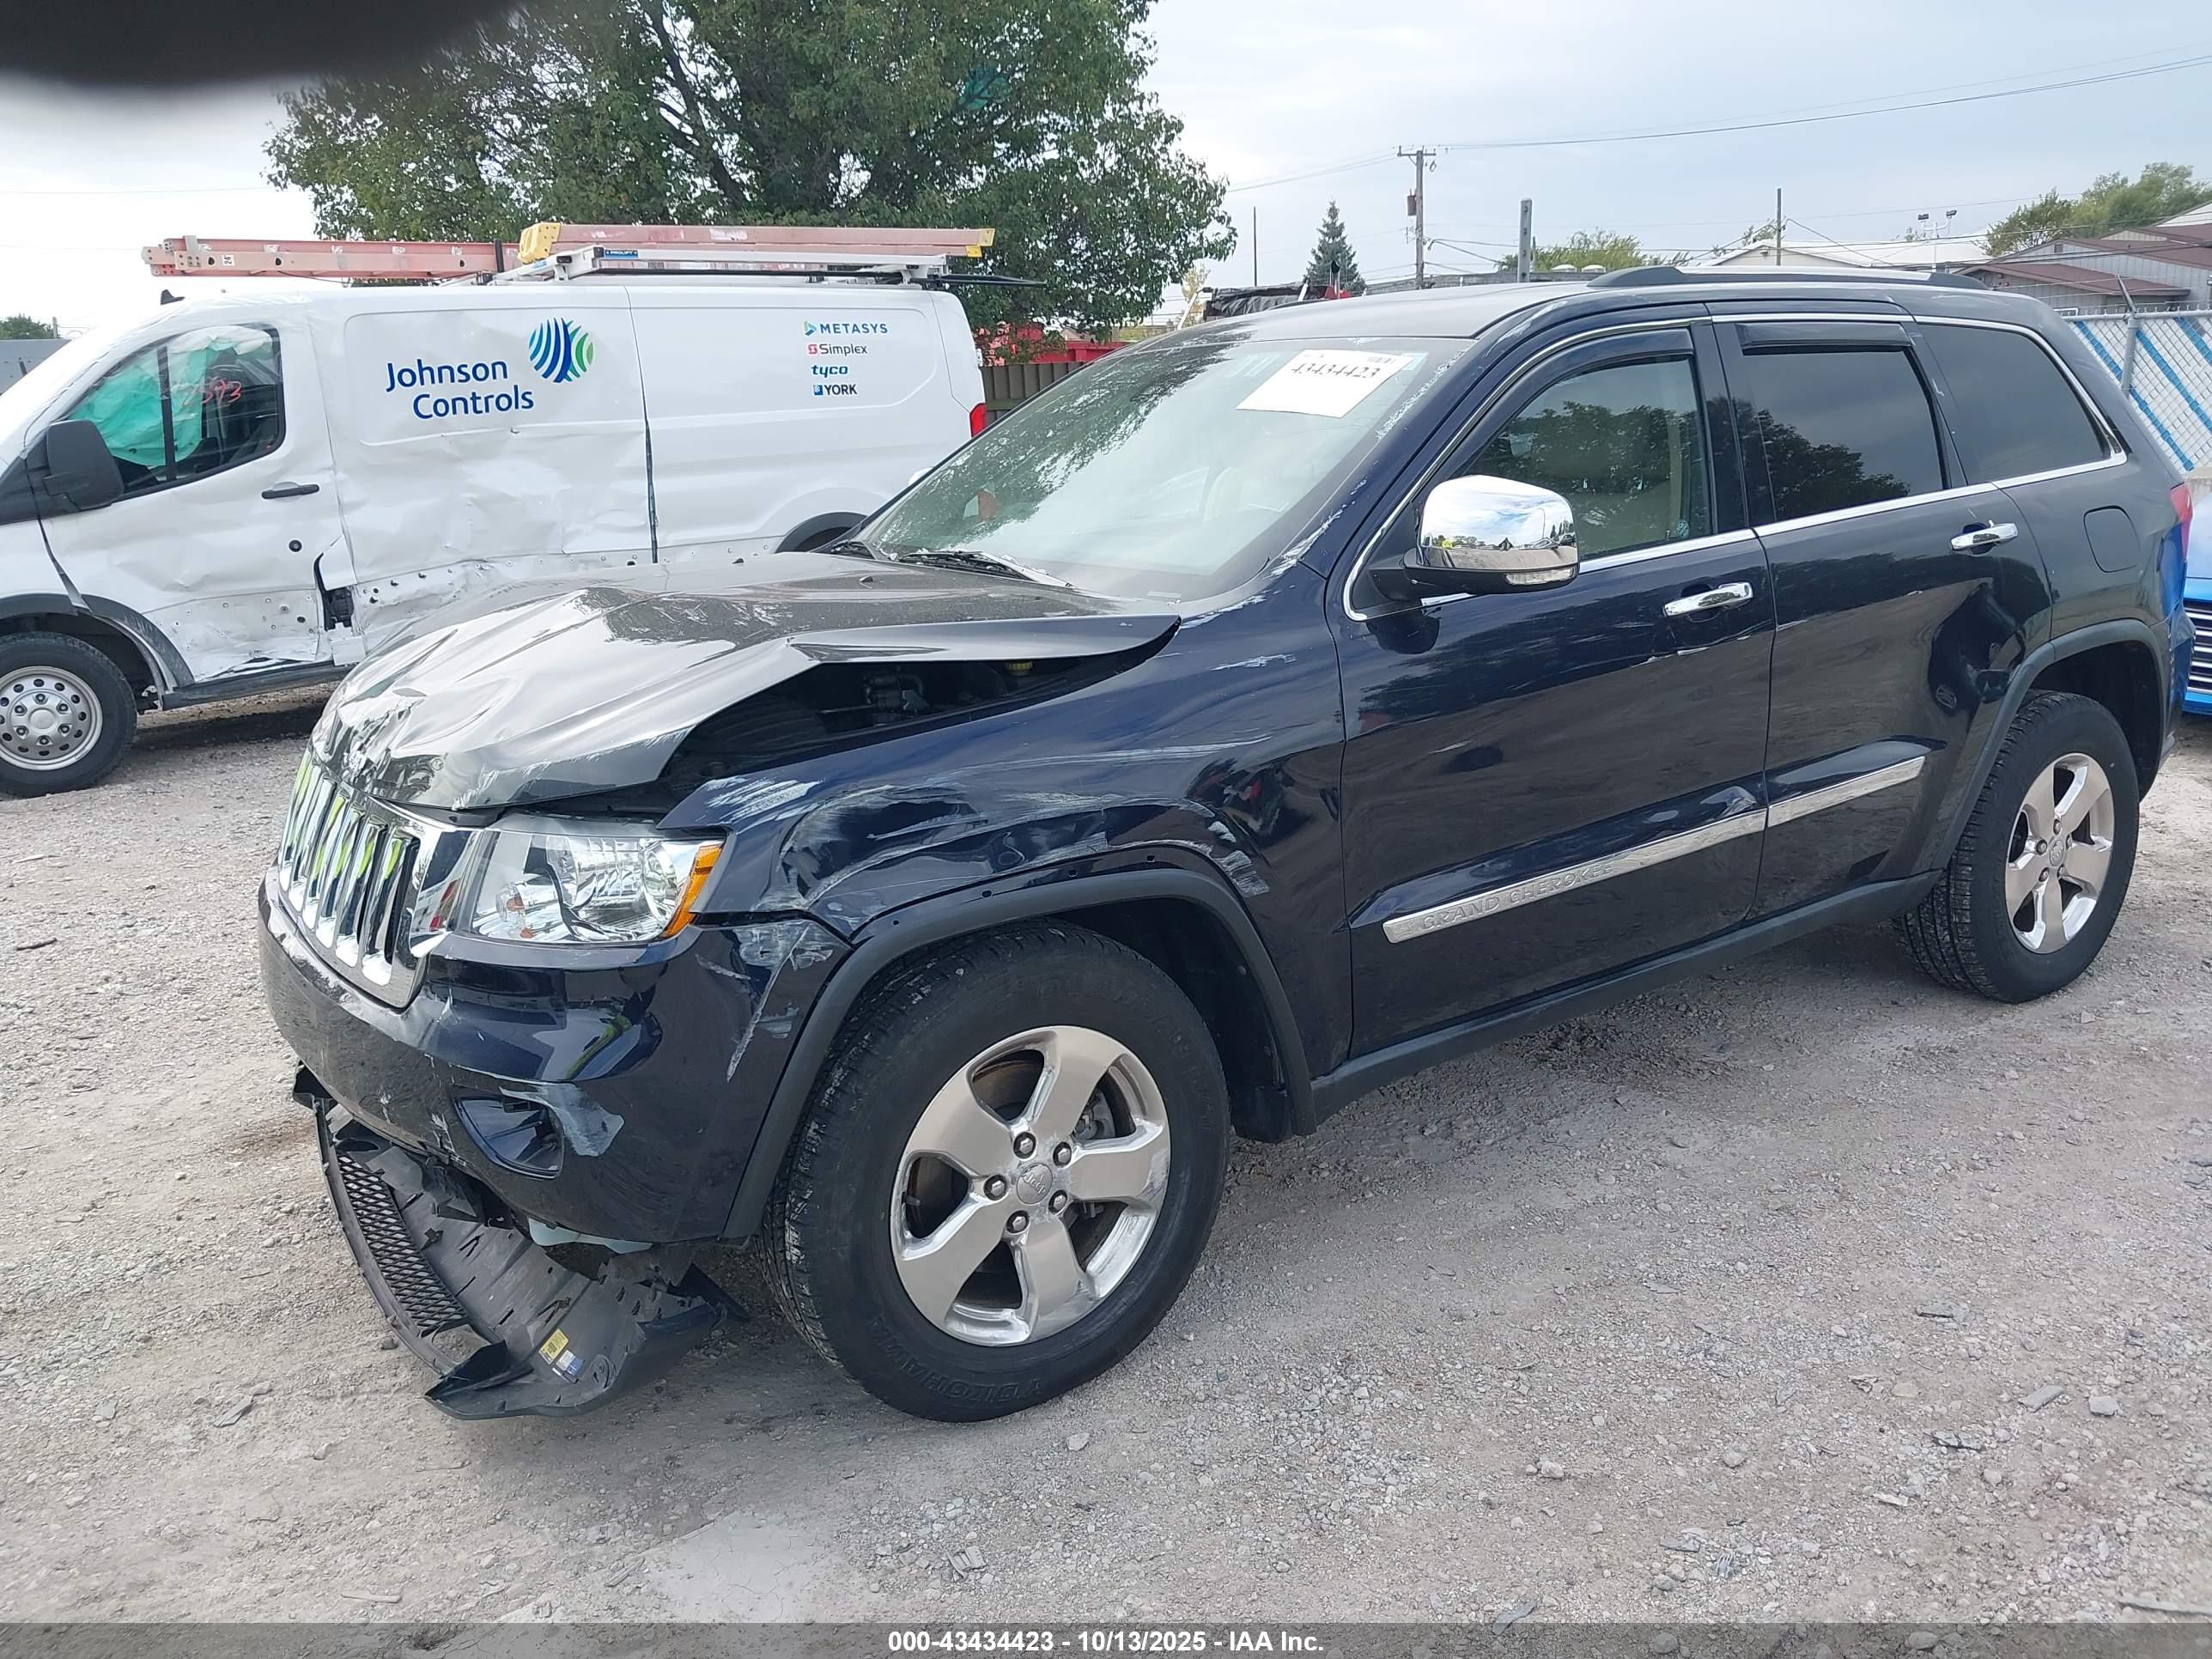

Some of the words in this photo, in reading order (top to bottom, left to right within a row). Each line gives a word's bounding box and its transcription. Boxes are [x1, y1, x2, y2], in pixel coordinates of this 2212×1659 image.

[819, 323, 889, 334] METASYS
[819, 343, 868, 357] Simplex
[386, 358, 508, 392] Johnson
[811, 364, 848, 379] tyco
[1291, 362, 1381, 379] 43434423
[823, 384, 858, 396] YORK
[413, 384, 535, 419] Controls
[1422, 896, 1500, 931] GRAND
[1510, 863, 1614, 904] CHEROKEE
